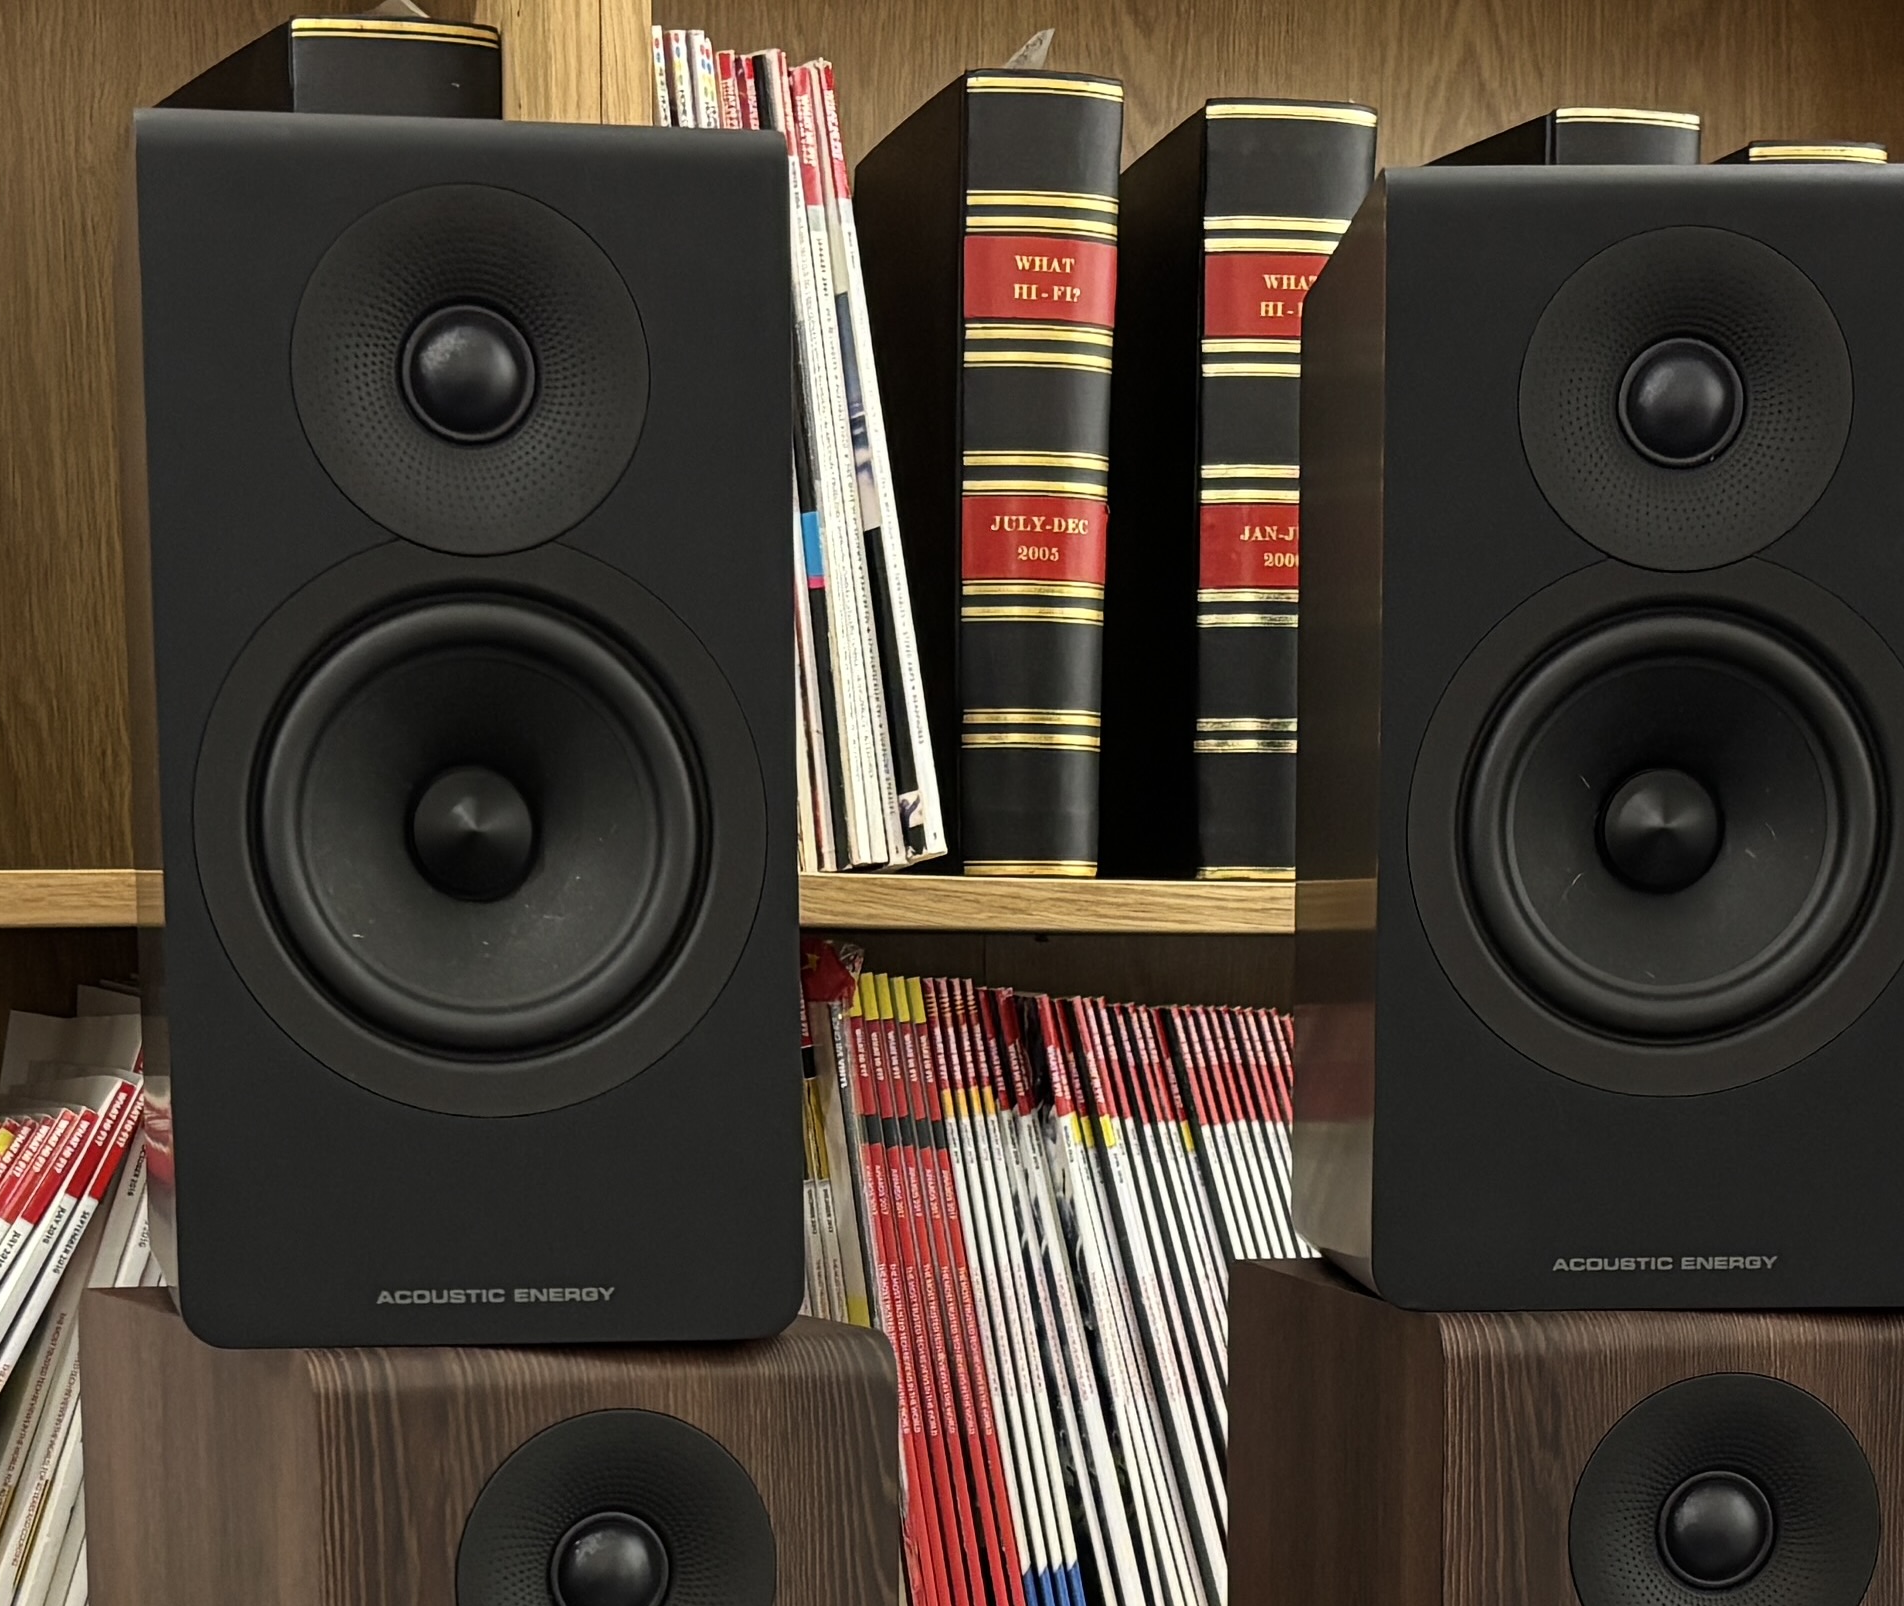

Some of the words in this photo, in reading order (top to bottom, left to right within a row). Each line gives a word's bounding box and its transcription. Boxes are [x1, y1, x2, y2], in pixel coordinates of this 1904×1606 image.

[1015, 255, 1075, 274] WHAT
[990, 515, 1090, 535] JULY-DEC
[1017, 545, 1059, 562] 2005
[1264, 553, 1299, 567] 200
[4, 1229, 21, 1249] JULY
[1552, 1257, 1674, 1271] ACOUSTIC
[1680, 1255, 1778, 1270] ENERGY
[376, 1288, 506, 1304] ACOUSTIC
[513, 1287, 615, 1303] ENERGY
